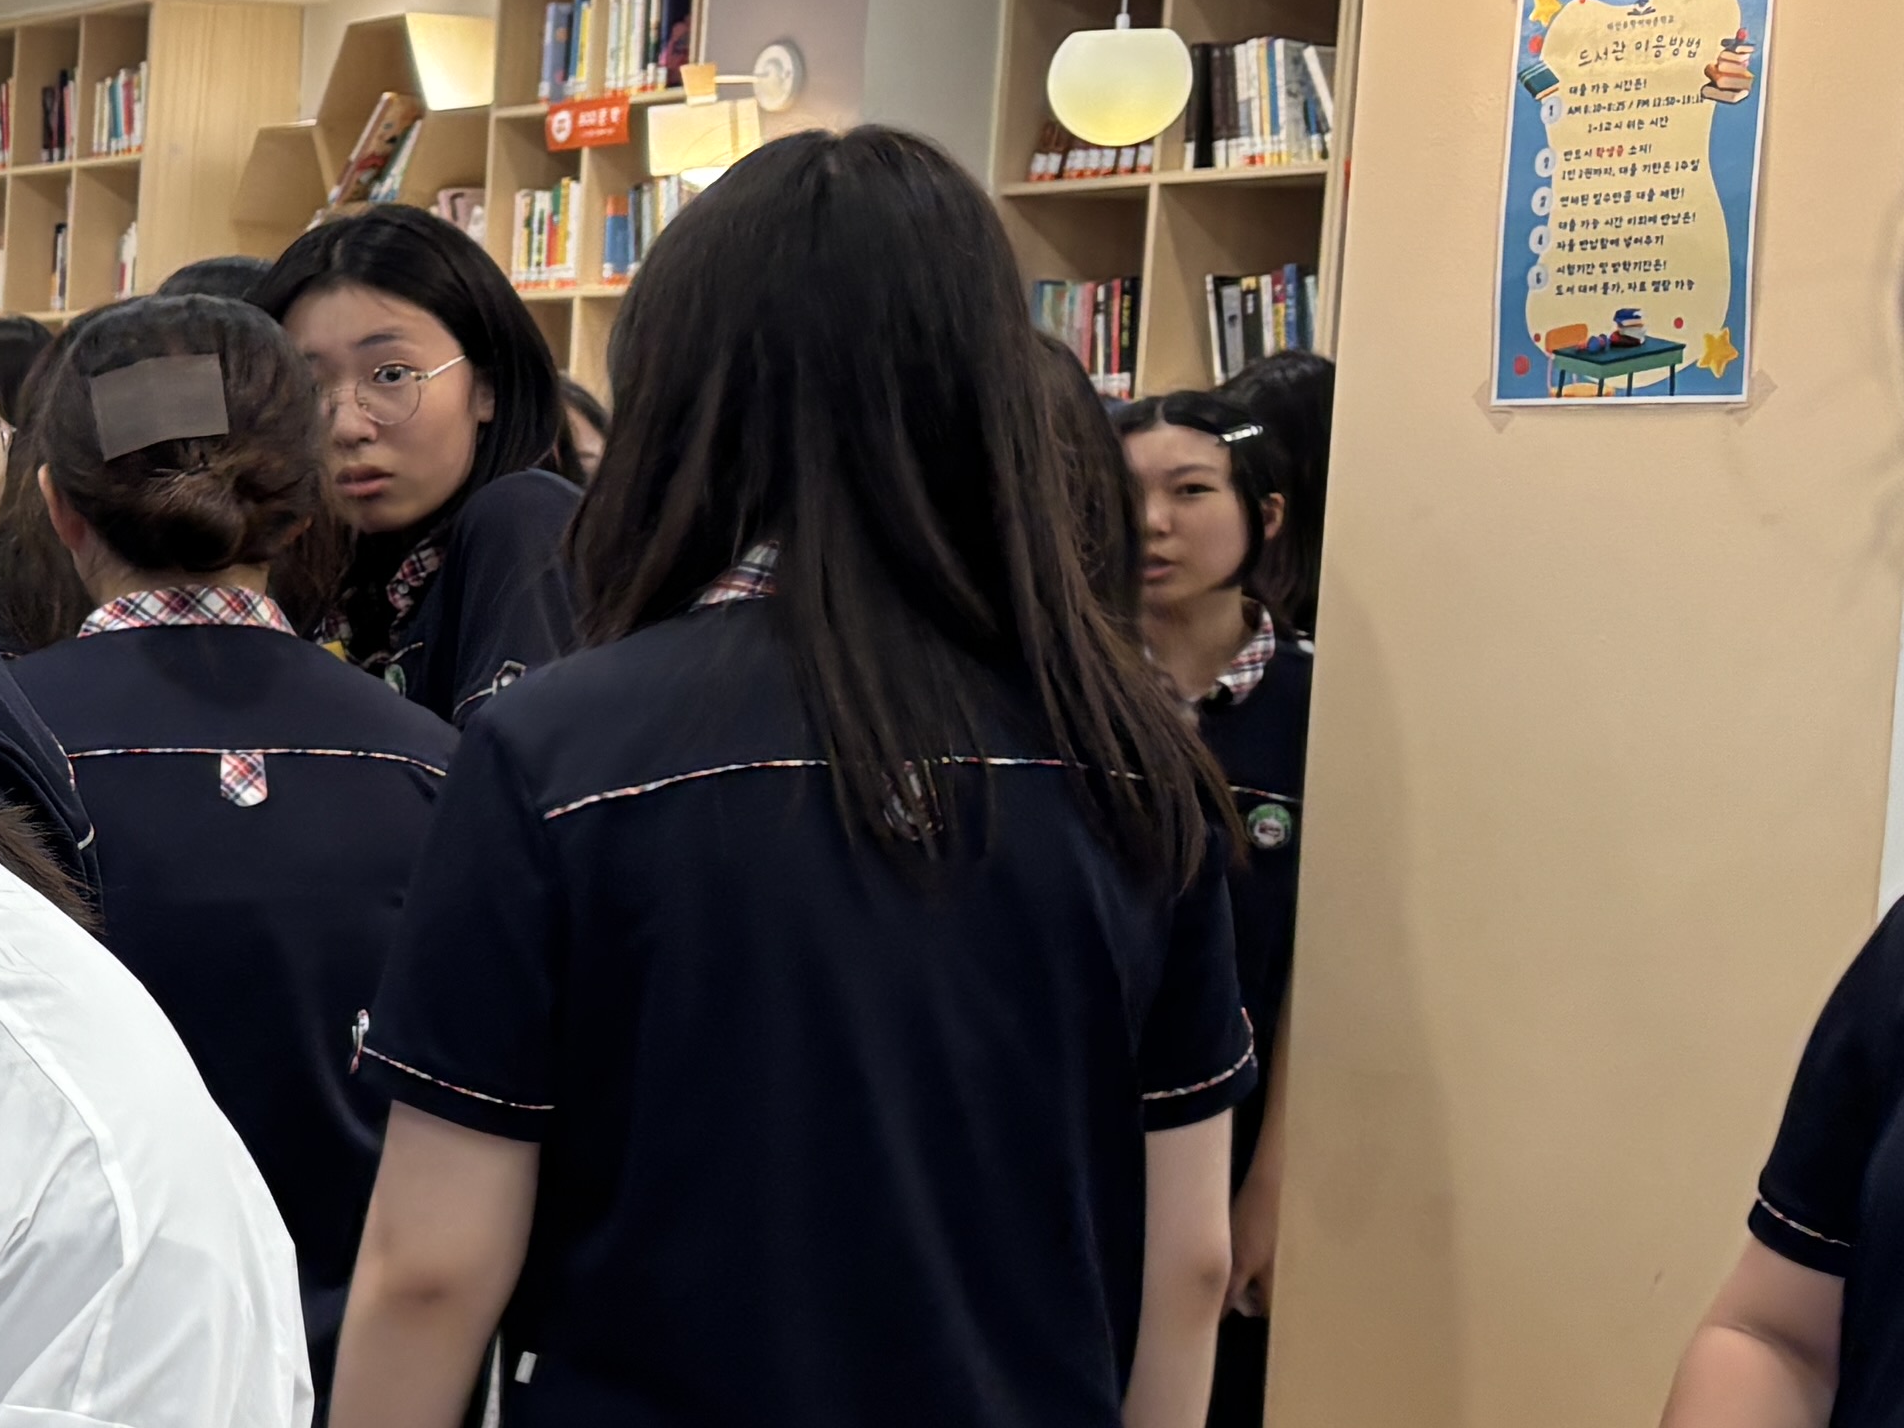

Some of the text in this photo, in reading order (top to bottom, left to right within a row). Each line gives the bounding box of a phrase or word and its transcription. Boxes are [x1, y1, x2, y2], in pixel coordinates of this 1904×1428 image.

[1635, 35, 1701, 59] 이용방법
[1567, 105, 1581, 115] AM
[1636, 98, 1649, 108] PM
[1650, 116, 1669, 128] 시간
[1605, 216, 1623, 228] 시간
